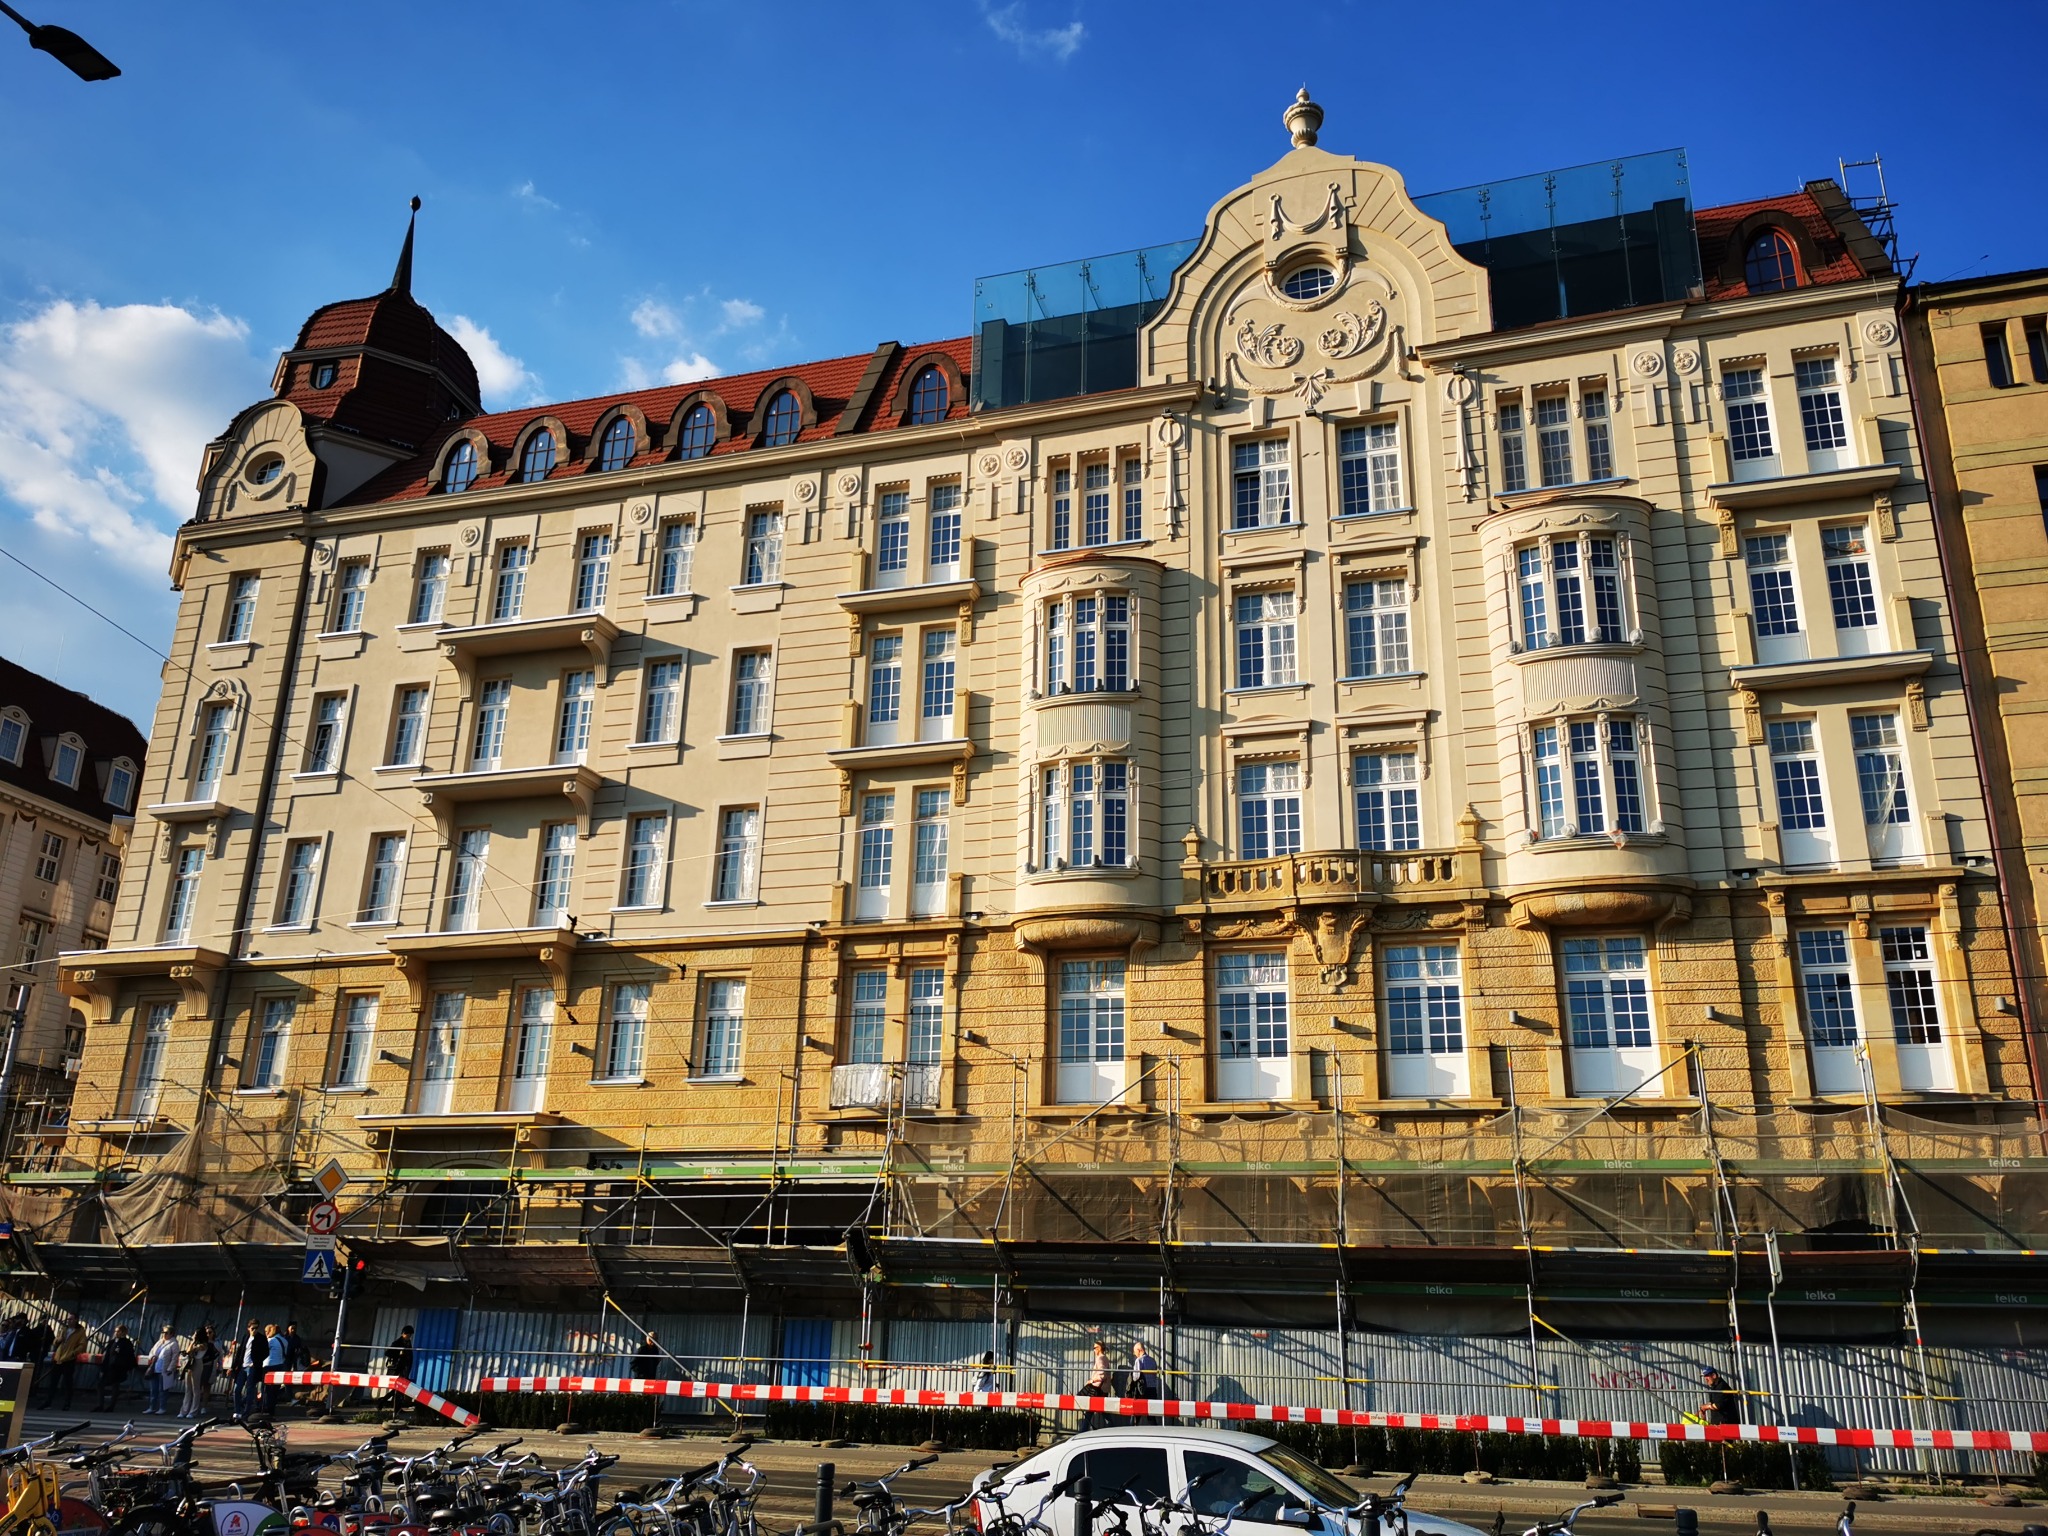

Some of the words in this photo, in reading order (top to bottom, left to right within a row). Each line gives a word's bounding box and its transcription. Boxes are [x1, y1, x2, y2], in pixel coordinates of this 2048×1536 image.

[1246, 1162, 1272, 1170] telka
[1418, 1160, 1444, 1169] telka
[1604, 1160, 1632, 1168] telka
[1988, 1158, 2020, 1168] telka
[704, 1166, 724, 1175] telka
[942, 1164, 964, 1172] telka
[933, 1275, 956, 1284] telka
[1079, 1278, 1102, 1286] telka
[1425, 1285, 1453, 1295] telka
[1620, 1288, 1650, 1298] telka
[1805, 1291, 1836, 1300] telka
[1995, 1294, 2028, 1304] telka
